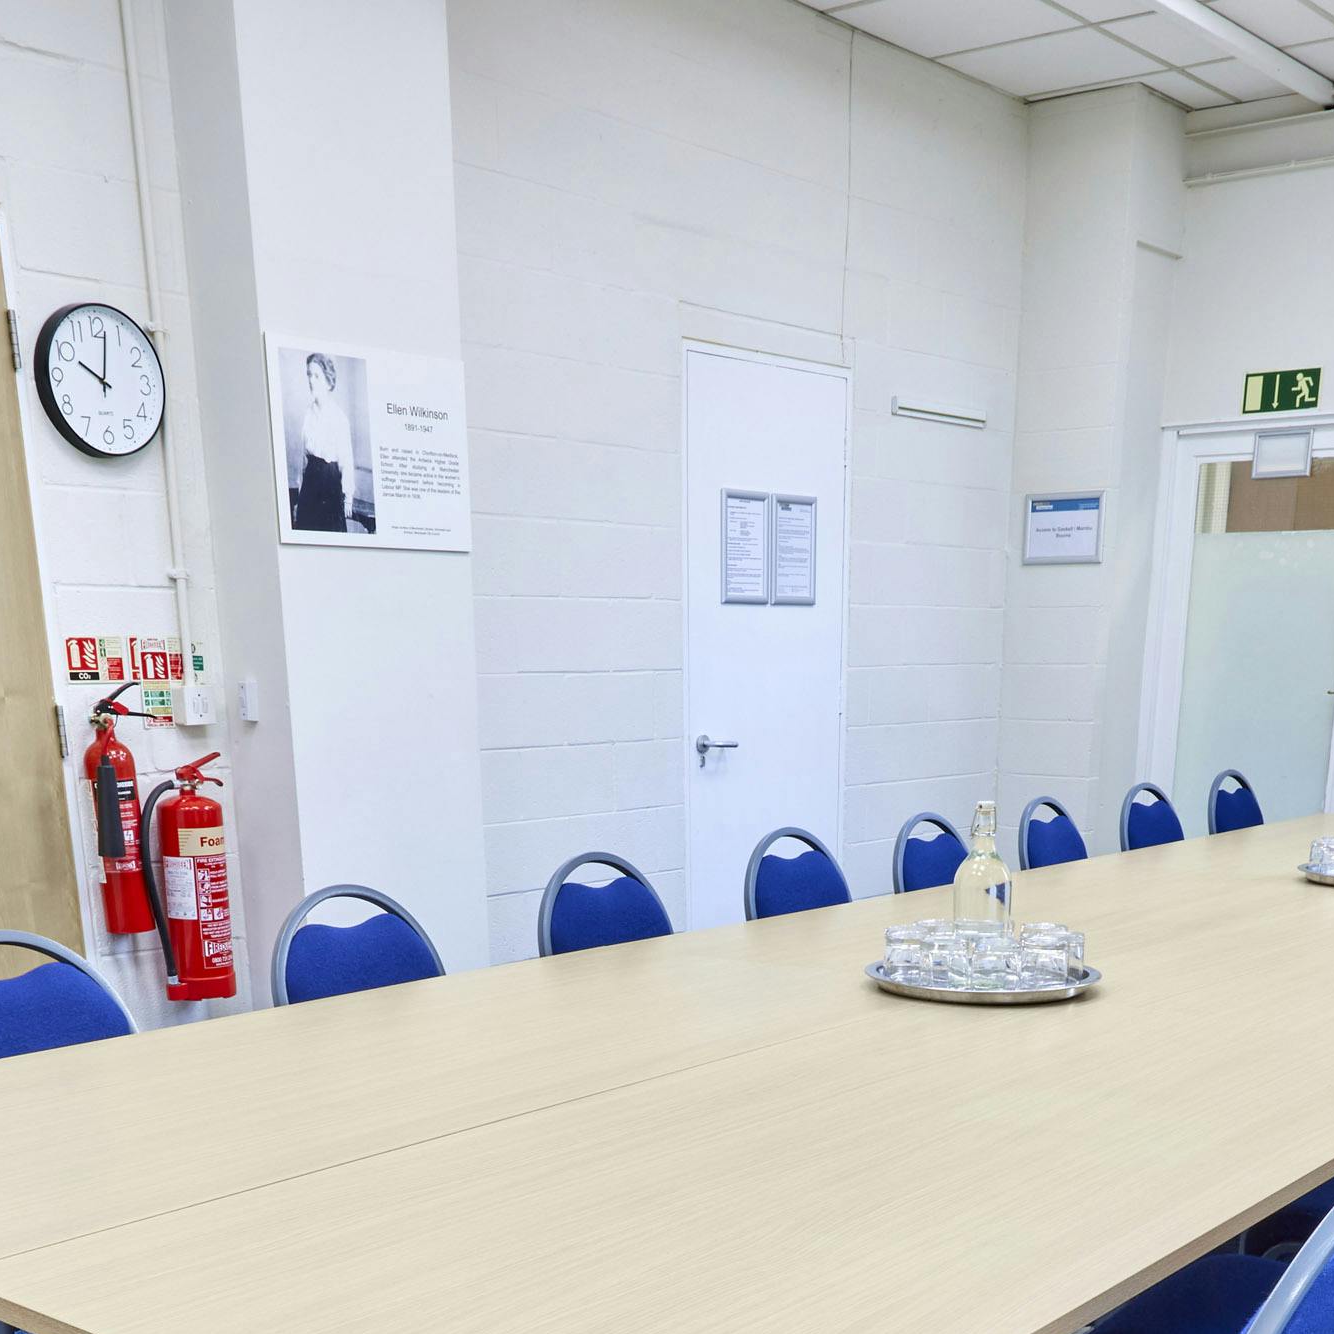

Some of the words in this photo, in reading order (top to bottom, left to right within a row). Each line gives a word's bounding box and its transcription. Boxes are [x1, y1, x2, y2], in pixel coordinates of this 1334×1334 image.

[70, 320, 83, 343] 11
[116, 325, 121, 346] 1
[55, 339, 75, 361] 10
[130, 347, 142, 368] 2
[51, 367, 64, 387] 9
[139, 375, 151, 396] 3
[61, 394, 74, 415] 8
[136, 402, 148, 422] 4
[386, 402, 408, 416] Ellen
[409, 405, 449, 421] Wilkinson
[80, 415, 91, 437] 7
[102, 425, 115, 445] 6
[122, 419, 135, 440] 5
[404, 423, 433, 433] 1891-1947
